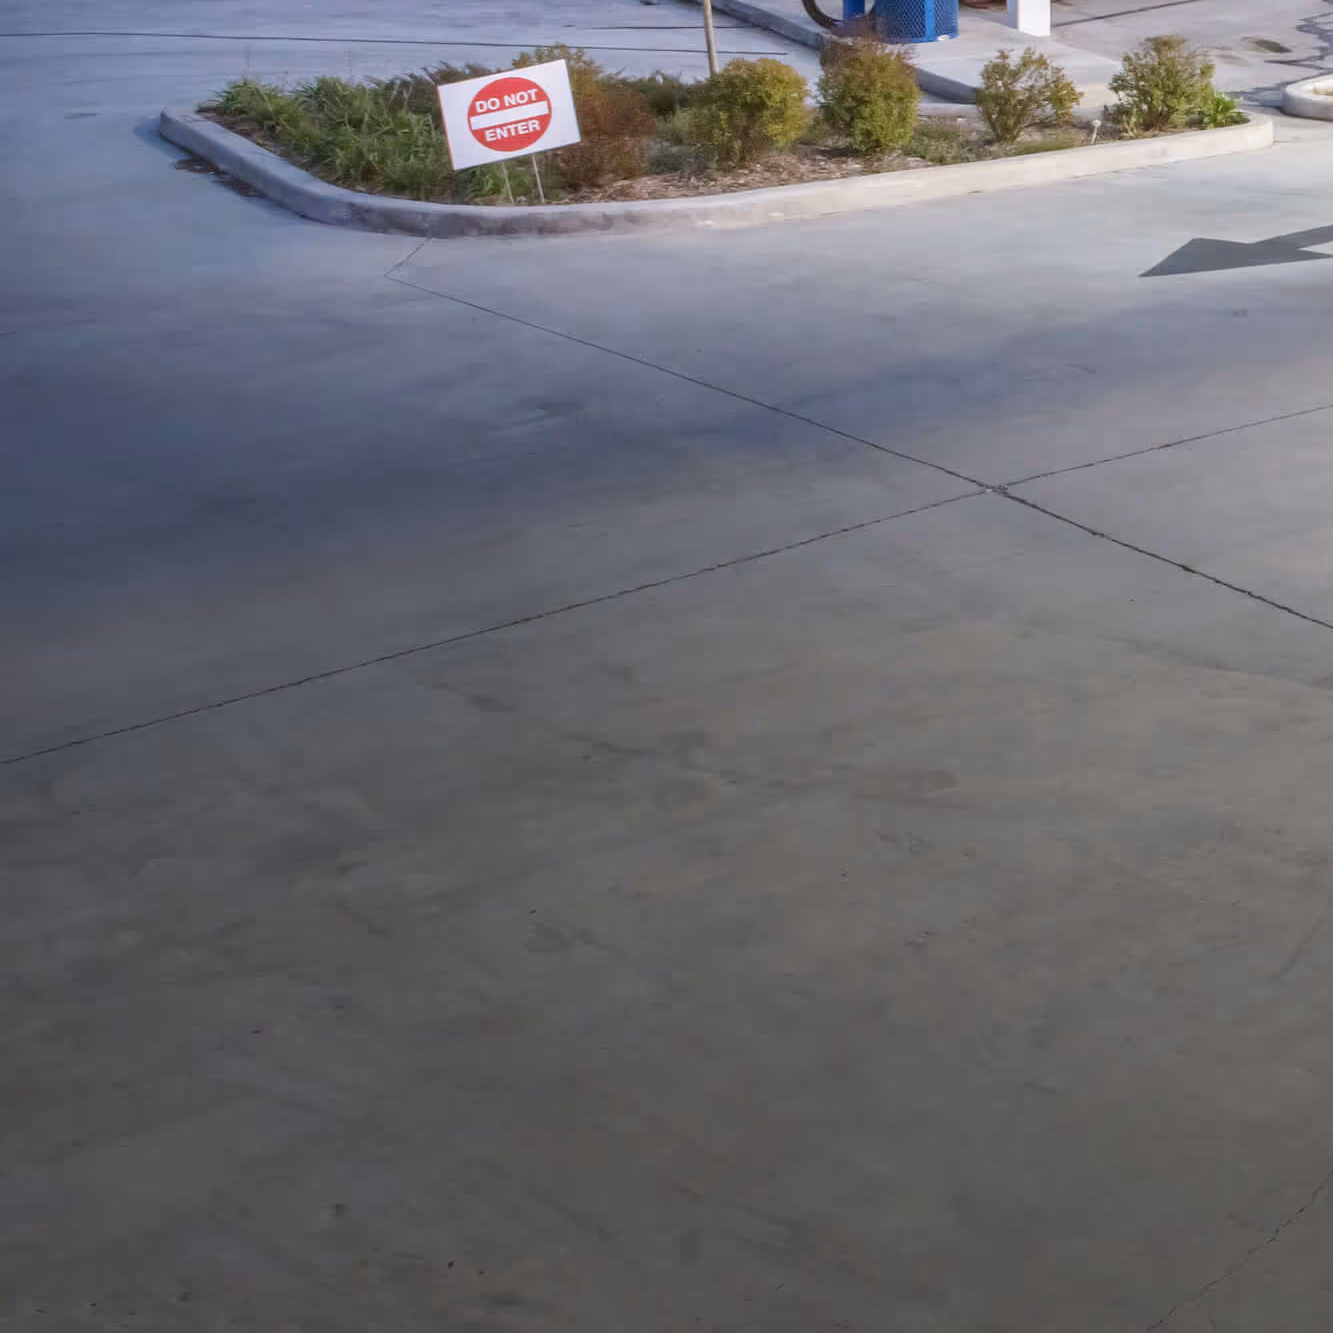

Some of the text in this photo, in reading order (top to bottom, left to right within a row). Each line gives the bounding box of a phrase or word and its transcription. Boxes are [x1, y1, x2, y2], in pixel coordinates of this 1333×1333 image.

[475, 88, 538, 114] DO NOT
[484, 119, 541, 142] ENTER
